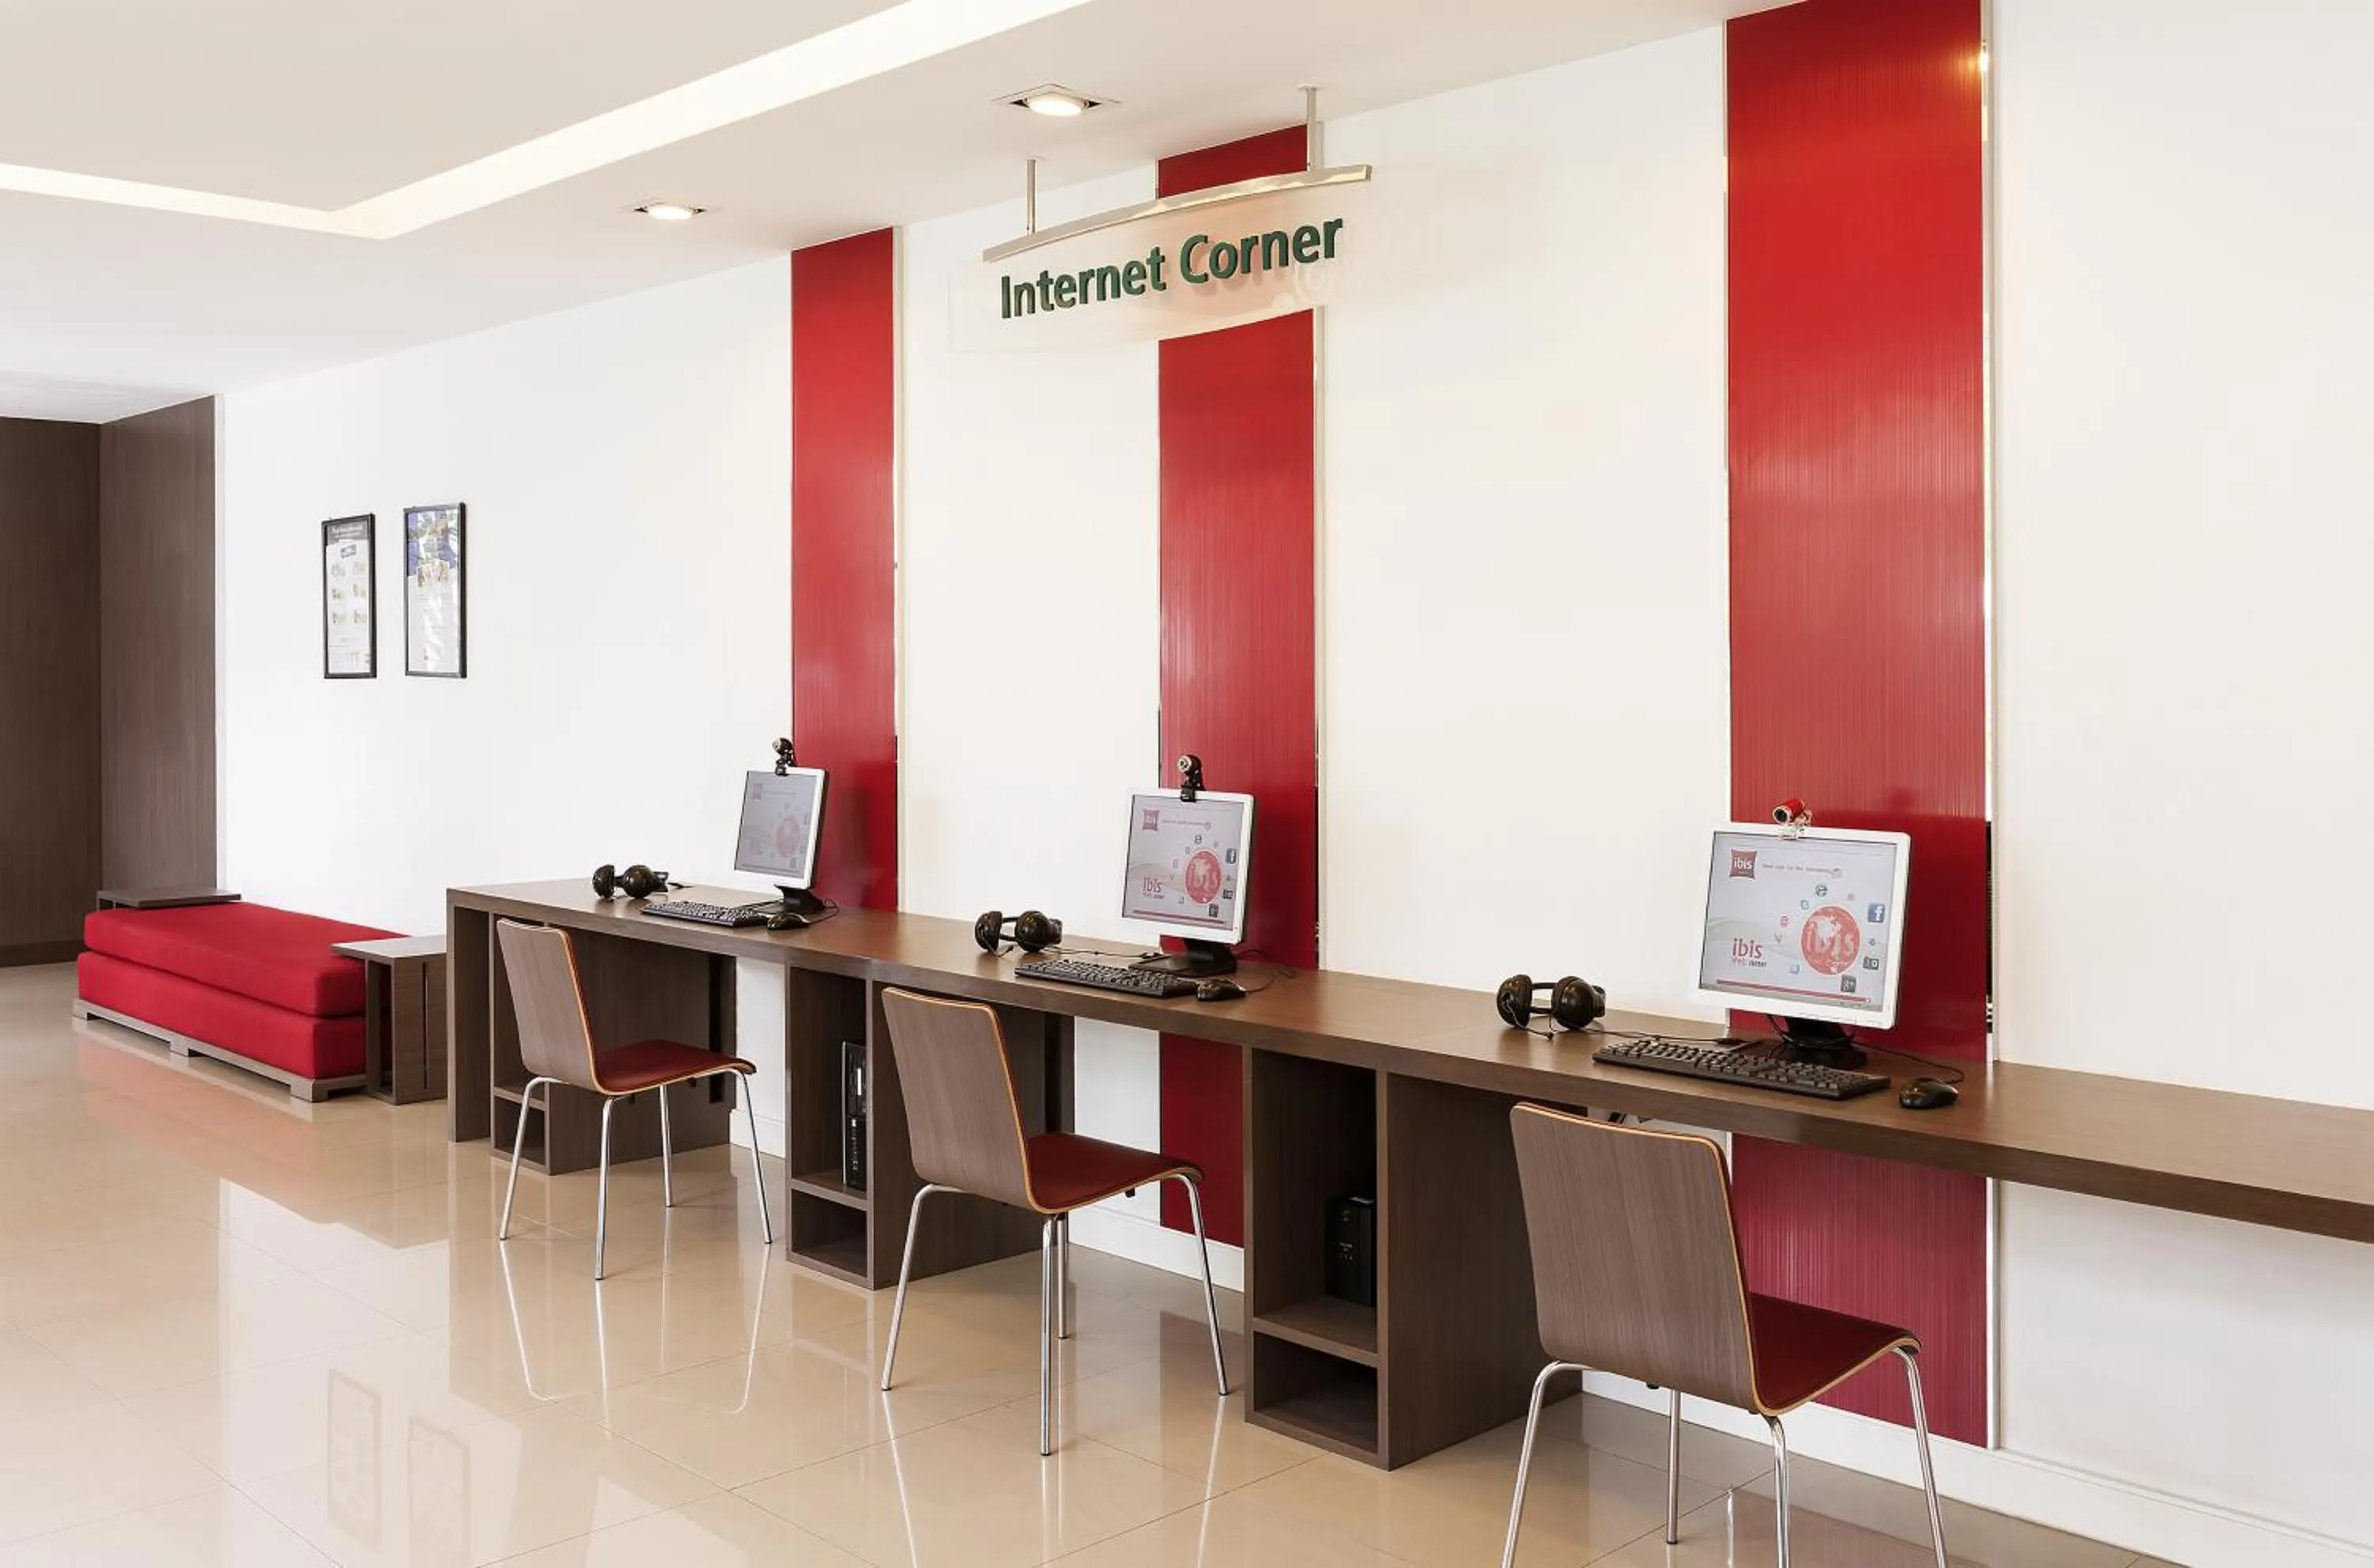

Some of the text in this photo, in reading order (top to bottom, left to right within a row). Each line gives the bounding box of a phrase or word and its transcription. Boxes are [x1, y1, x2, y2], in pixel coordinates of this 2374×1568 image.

[1000, 217, 1344, 319] Internet Corner
[1734, 857, 1754, 869] ibis
[1142, 877, 1164, 893] ibis
[1732, 937, 1763, 959] ibis
